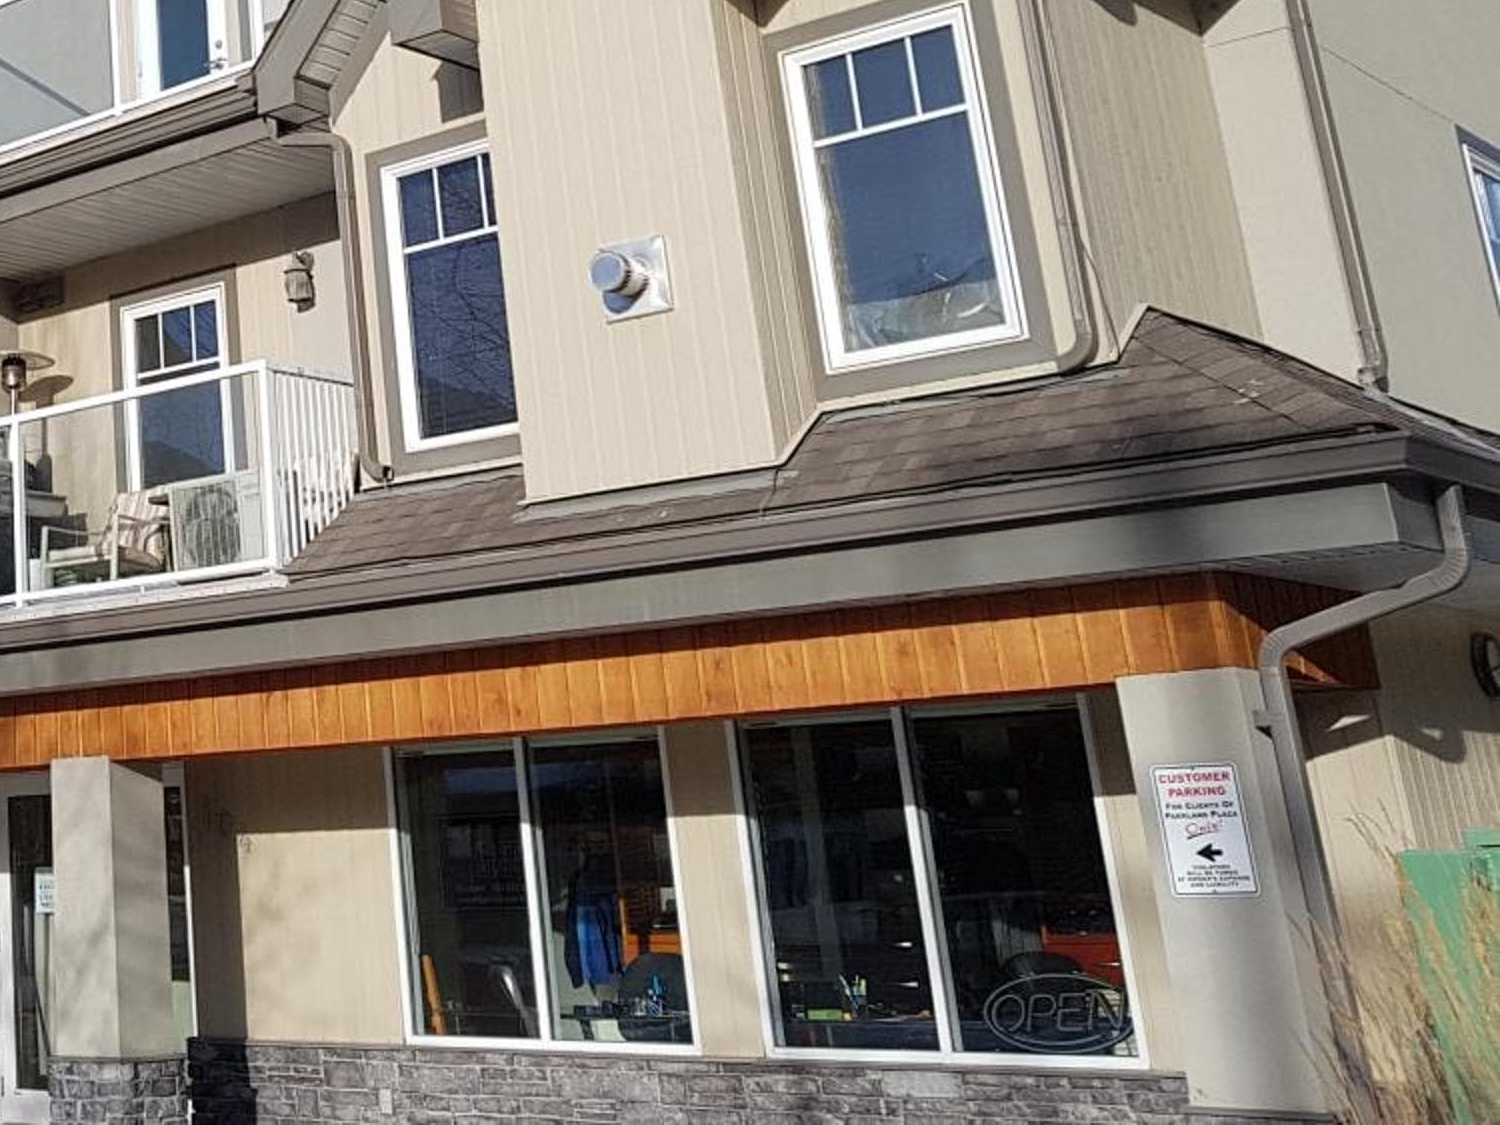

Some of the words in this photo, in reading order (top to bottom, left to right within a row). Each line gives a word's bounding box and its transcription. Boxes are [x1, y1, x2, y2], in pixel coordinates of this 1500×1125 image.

[1158, 771, 1230, 784] CUSTOMER
[1168, 786, 1227, 797] PARKING
[991, 988, 1125, 1033] OPEN
